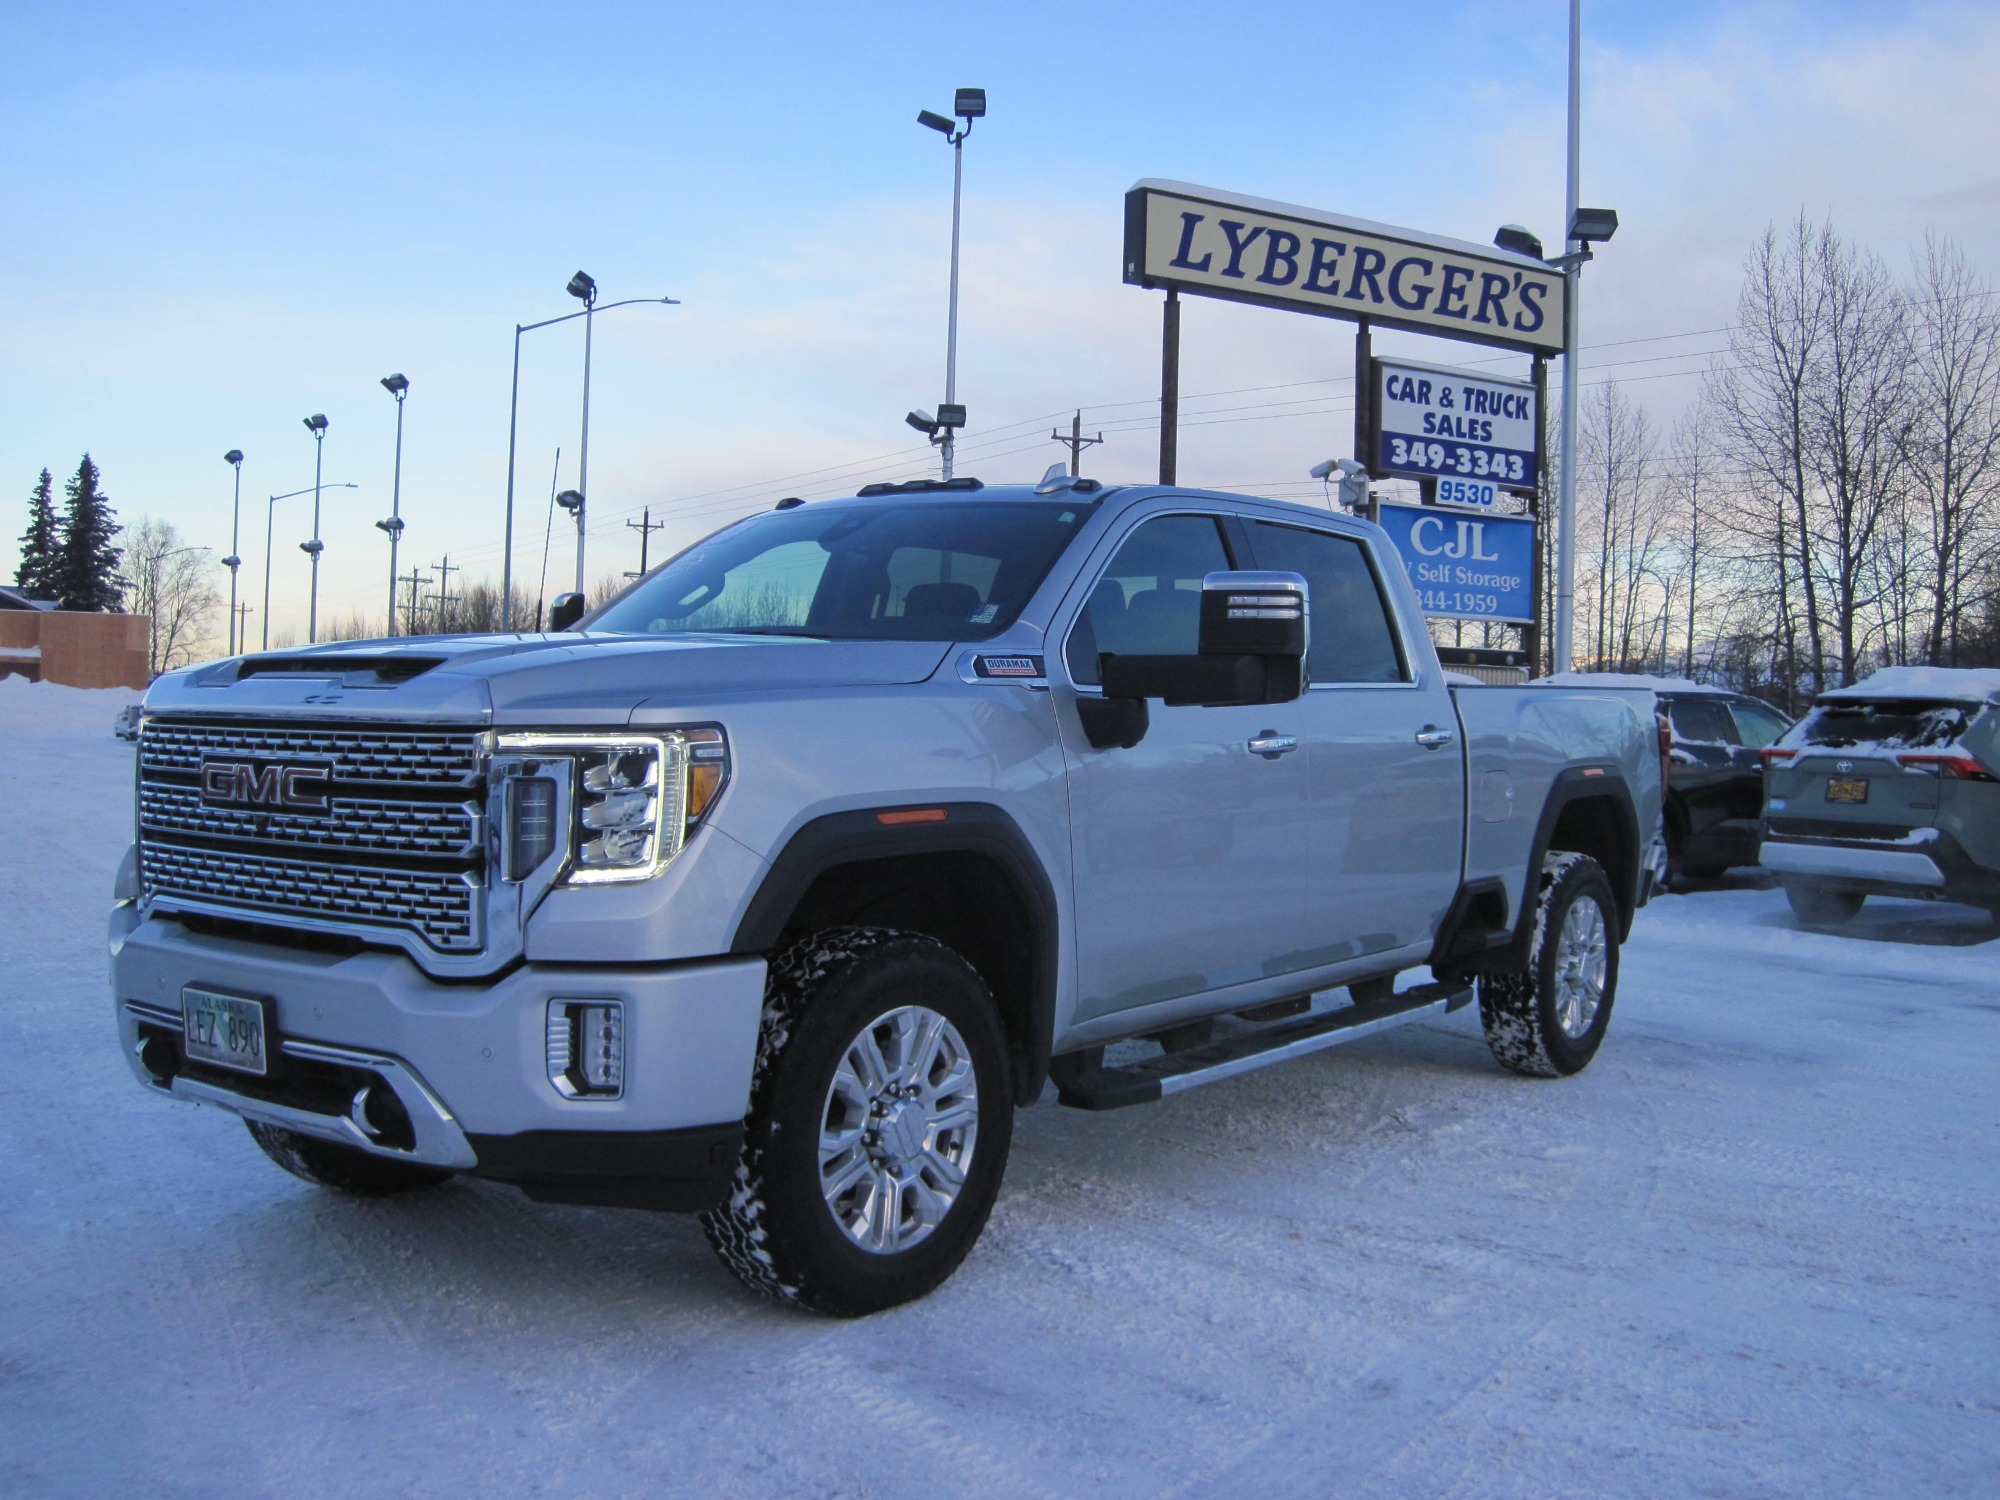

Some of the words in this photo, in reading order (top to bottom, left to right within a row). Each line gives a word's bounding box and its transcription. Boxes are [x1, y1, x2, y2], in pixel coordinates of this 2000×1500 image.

[1169, 212, 1548, 333] LYBERGER'S
[1386, 375, 1432, 405] CAR
[1439, 386, 1454, 409] &
[1462, 387, 1529, 420] TRUCK
[1423, 412, 1493, 442] SALES
[1391, 439, 1524, 480] 349-3343
[1440, 480, 1493, 506] 9530
[1410, 517, 1498, 561] CJL
[1417, 562, 1451, 583] Self
[1455, 566, 1520, 592] Storage
[987, 659, 1032, 668] DURAMAX
[201, 763, 329, 807] GMC
[186, 1007, 217, 1048] LEZ
[228, 1016, 260, 1056] 890
